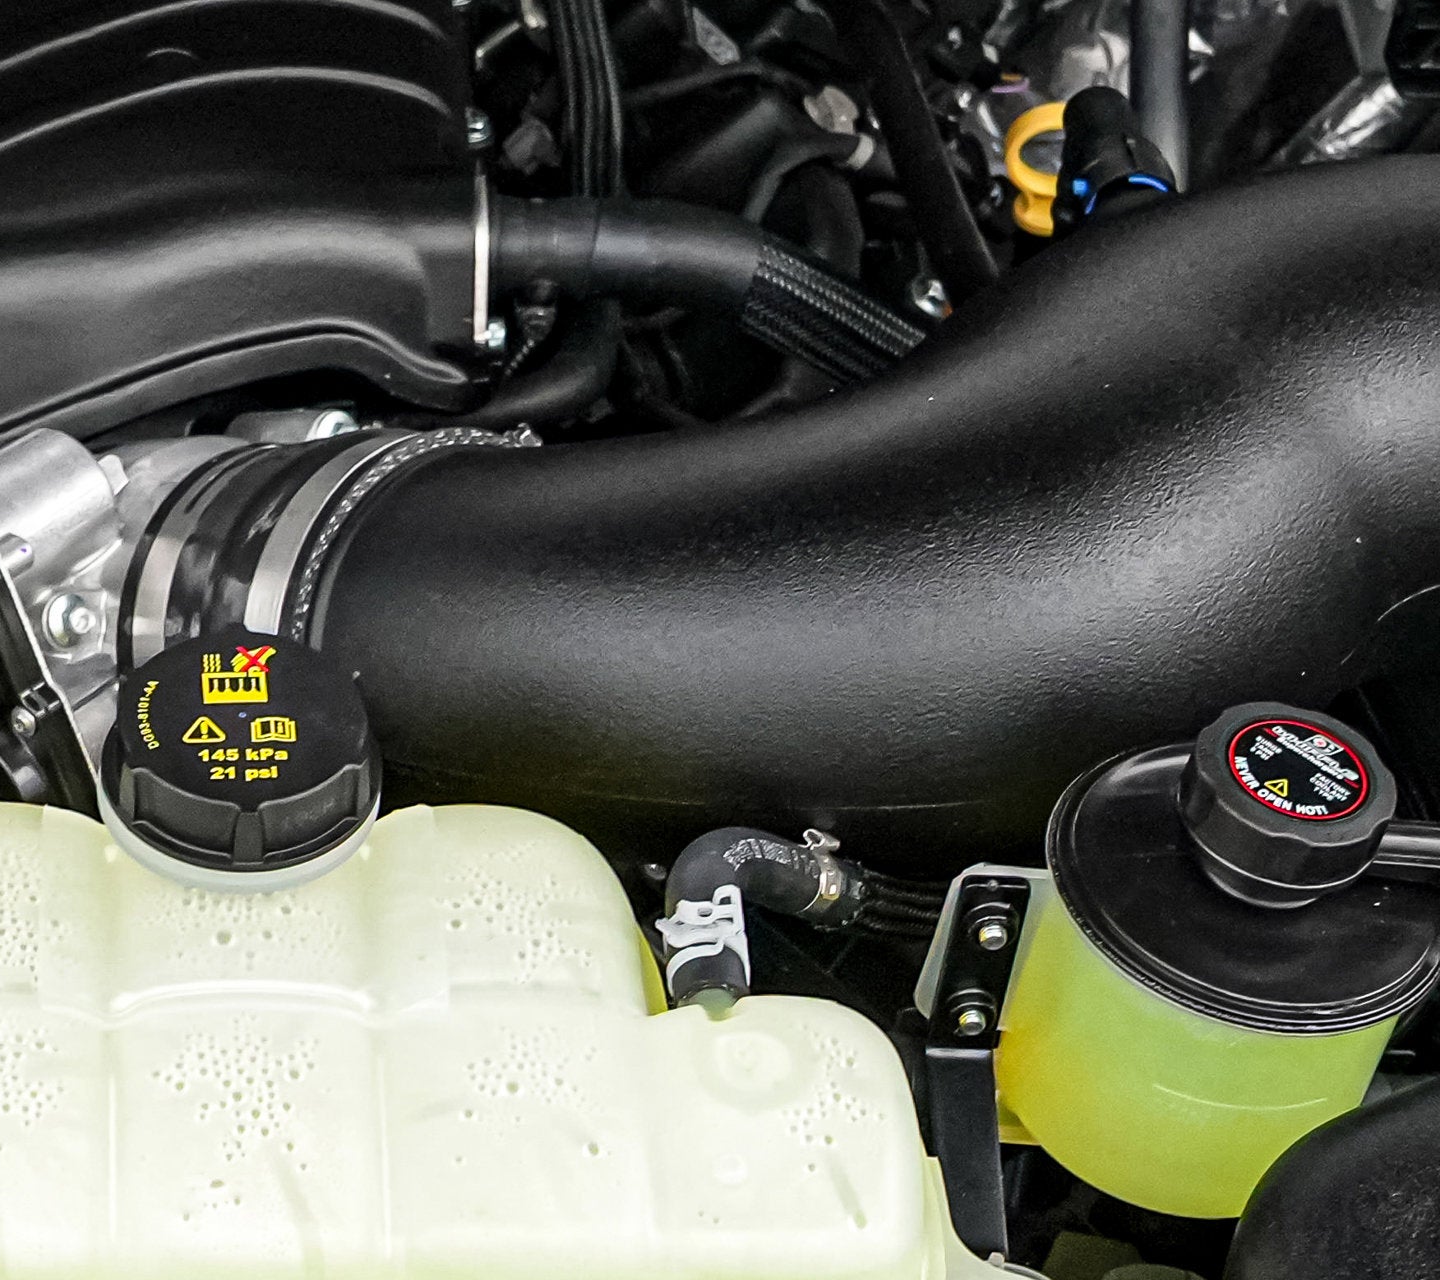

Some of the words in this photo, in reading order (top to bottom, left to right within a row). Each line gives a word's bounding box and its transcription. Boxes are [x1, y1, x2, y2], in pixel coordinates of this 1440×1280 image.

[197, 748, 239, 762] 145
[245, 747, 289, 762] kPa
[209, 766, 236, 780] 21
[244, 765, 279, 782] psi
[1234, 756, 1260, 790] NEVER
[1257, 788, 1293, 811] OPEN
